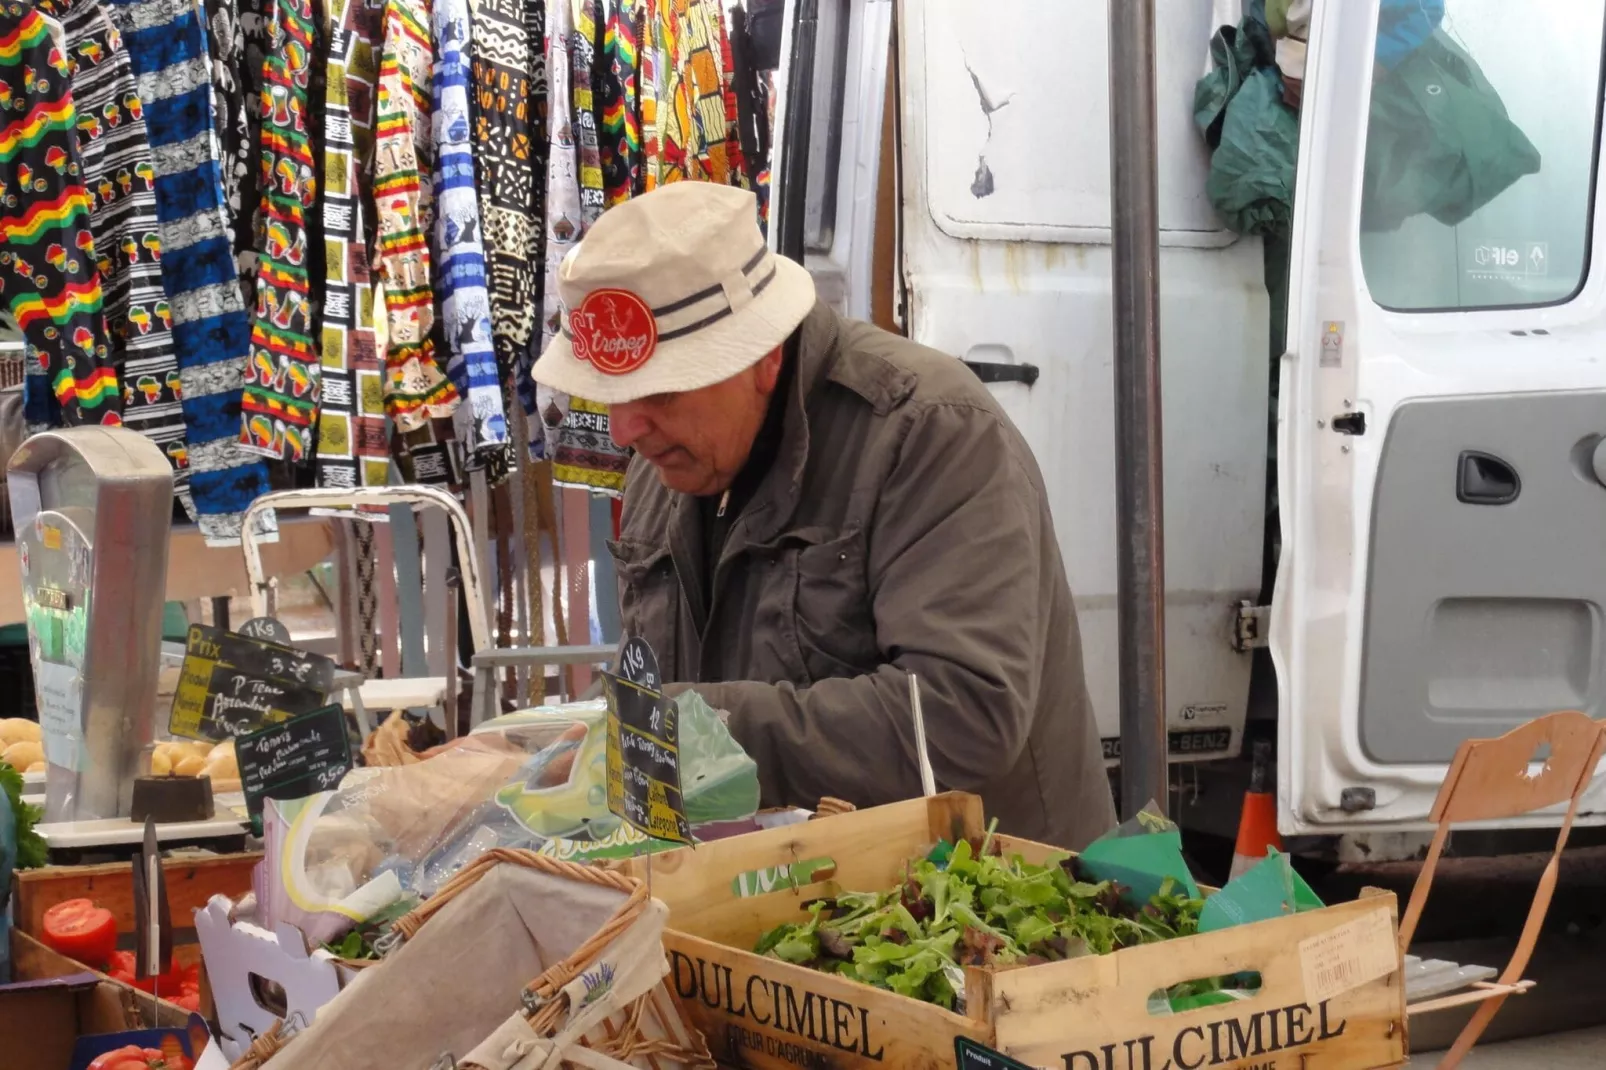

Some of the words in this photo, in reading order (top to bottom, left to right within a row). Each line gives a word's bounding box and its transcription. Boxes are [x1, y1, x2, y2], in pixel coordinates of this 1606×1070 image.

[188, 627, 222, 659] Prix
[670, 949, 884, 1061] DULCIMIEL
[963, 1049, 993, 1067] Produit
